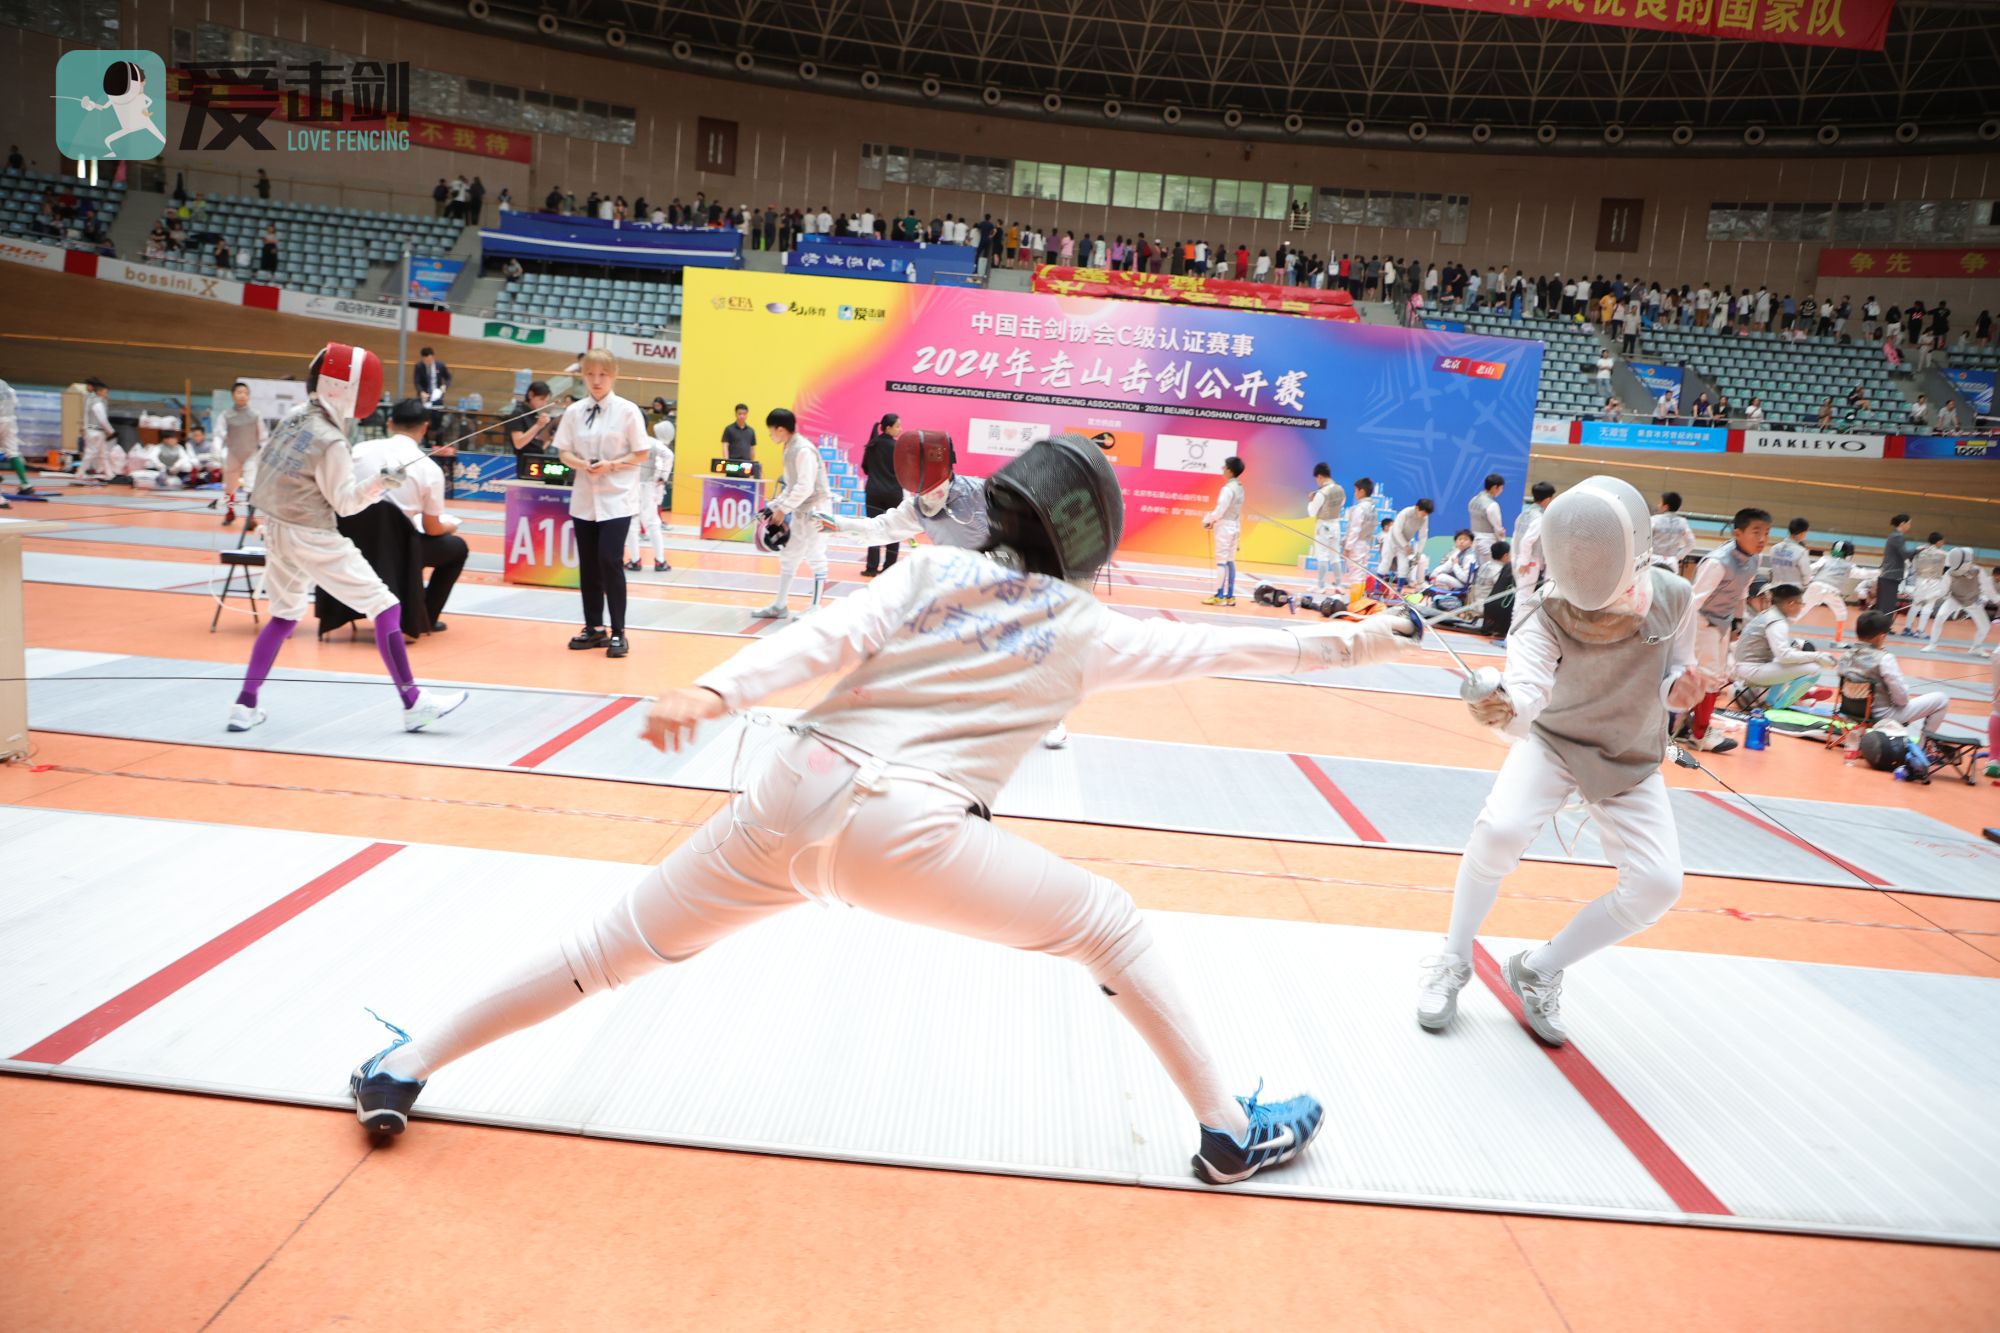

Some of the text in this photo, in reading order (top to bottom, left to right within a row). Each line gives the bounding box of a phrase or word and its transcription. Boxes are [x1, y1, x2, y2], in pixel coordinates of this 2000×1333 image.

[1508, 0, 1846, 38] 优良的国家队
[1850, 252, 1912, 273] 争先
[728, 296, 753, 308] CFA
[633, 342, 677, 359] TEAM
[970, 311, 1255, 357] 中国击剑协会C级认证赛事
[912, 345, 1308, 411] 2024年老山击剑公开赛
[892, 383, 1321, 428] CLASS C CERTIFICATION EVENT OF CHINA FENCING ASSOCIATION 2024 BEIJING LAOSHAN OPEN CHAMPIONSHIPS
[1758, 438, 1836, 450] OAKLEY
[705, 497, 754, 530] A08
[509, 515, 580, 569] A10
